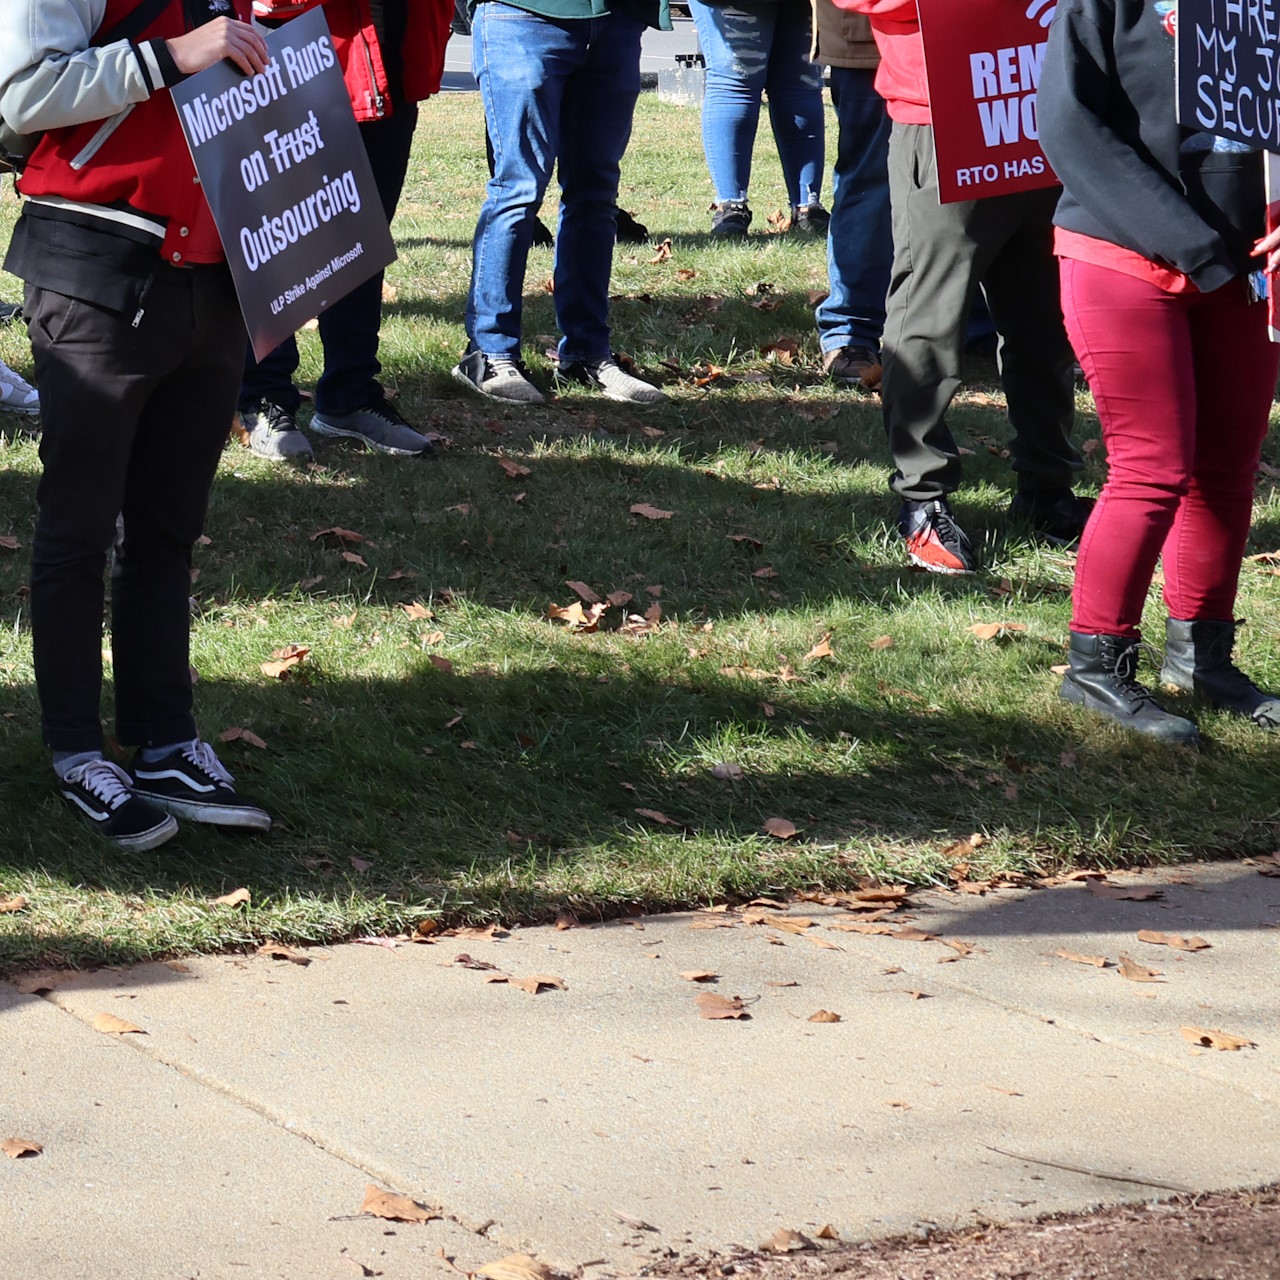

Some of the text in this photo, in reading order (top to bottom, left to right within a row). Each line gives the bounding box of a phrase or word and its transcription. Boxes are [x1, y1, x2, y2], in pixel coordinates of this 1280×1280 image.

[182, 34, 335, 147] Microsoft Runs
[1196, 23, 1237, 84] MY
[240, 109, 325, 193] on Trust
[956, 156, 1045, 187] RTO HAS
[240, 169, 361, 272] Outsourcing
[270, 242, 364, 315] ULP Strike Against Microsoft
